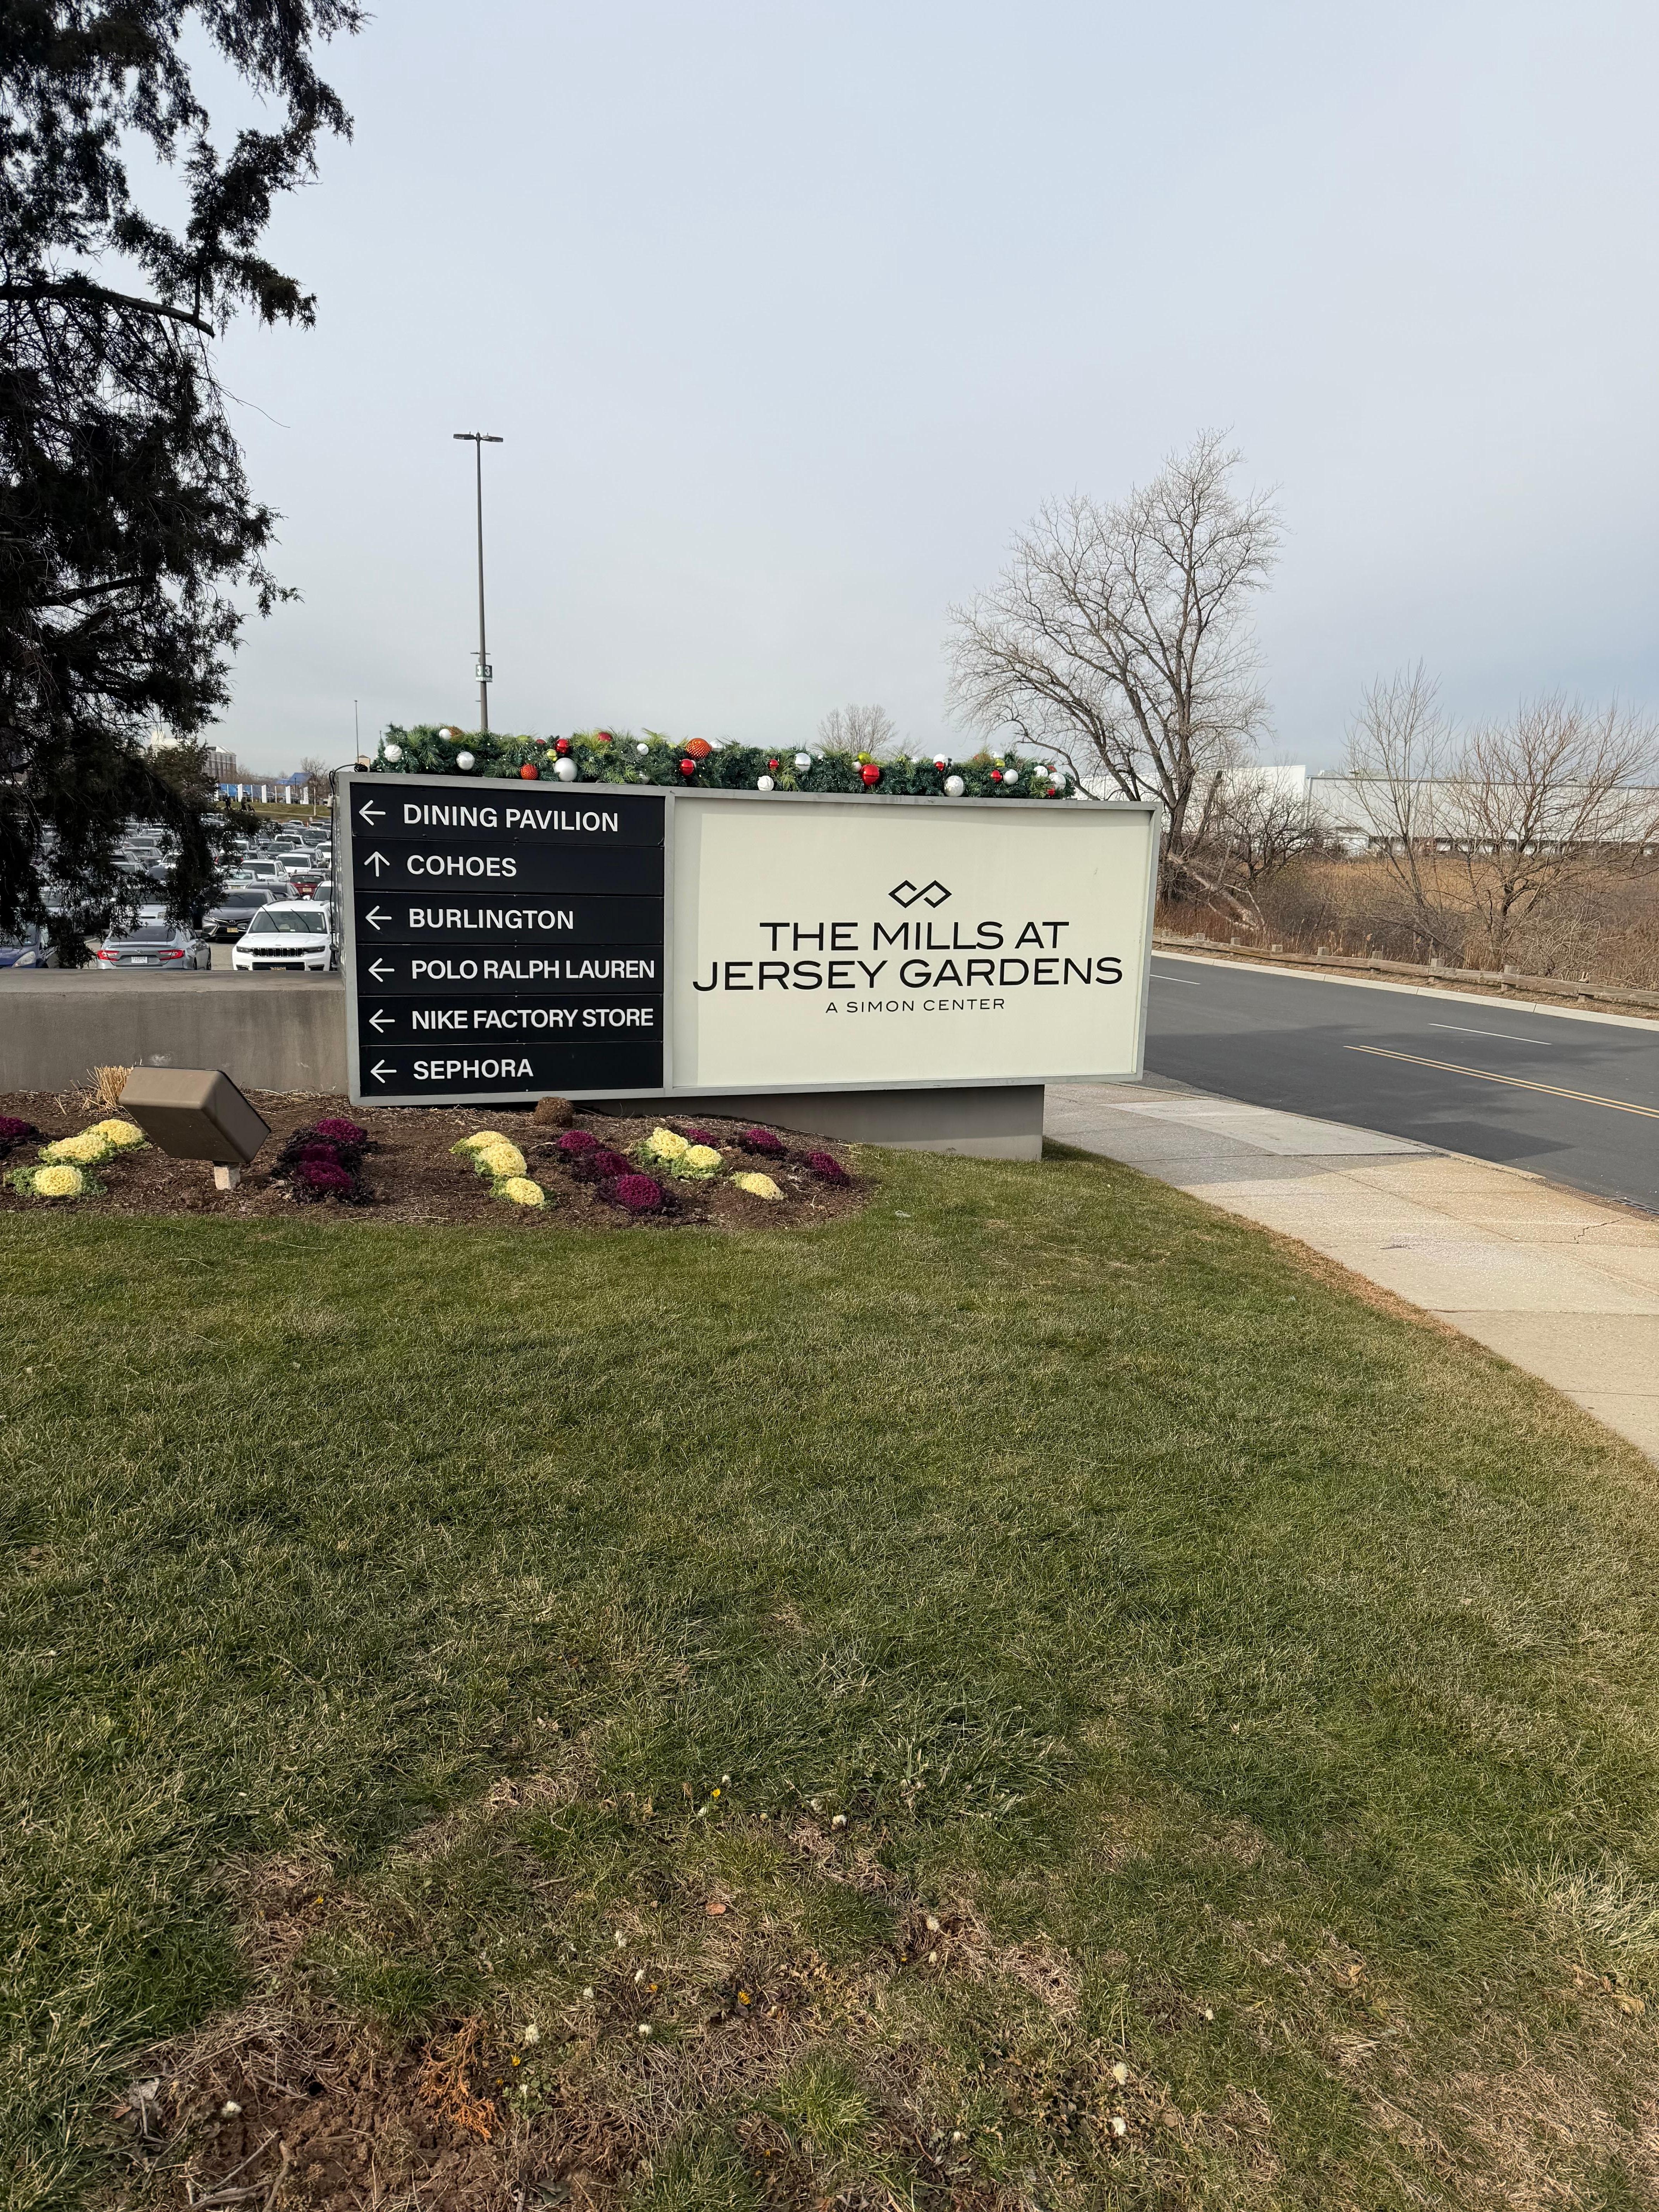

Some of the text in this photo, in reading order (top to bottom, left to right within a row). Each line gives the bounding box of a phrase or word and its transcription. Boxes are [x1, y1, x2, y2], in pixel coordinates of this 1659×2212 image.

[477, 665, 481, 676] 3
[485, 666, 490, 676] 3
[404, 804, 618, 832] DINING PAVILION
[407, 855, 517, 877] COHOES
[409, 908, 573, 929] BURLINGTON
[759, 921, 1069, 951] THE MILLS AT
[412, 960, 654, 979] POLO RALPH LAUREN
[692, 957, 1122, 991] JERSEY GARDENS
[825, 998, 1005, 1013] A SIMON CENTER
[412, 1008, 654, 1029] NIKE FACTORY STORE
[413, 1059, 534, 1080] SEPHORA
